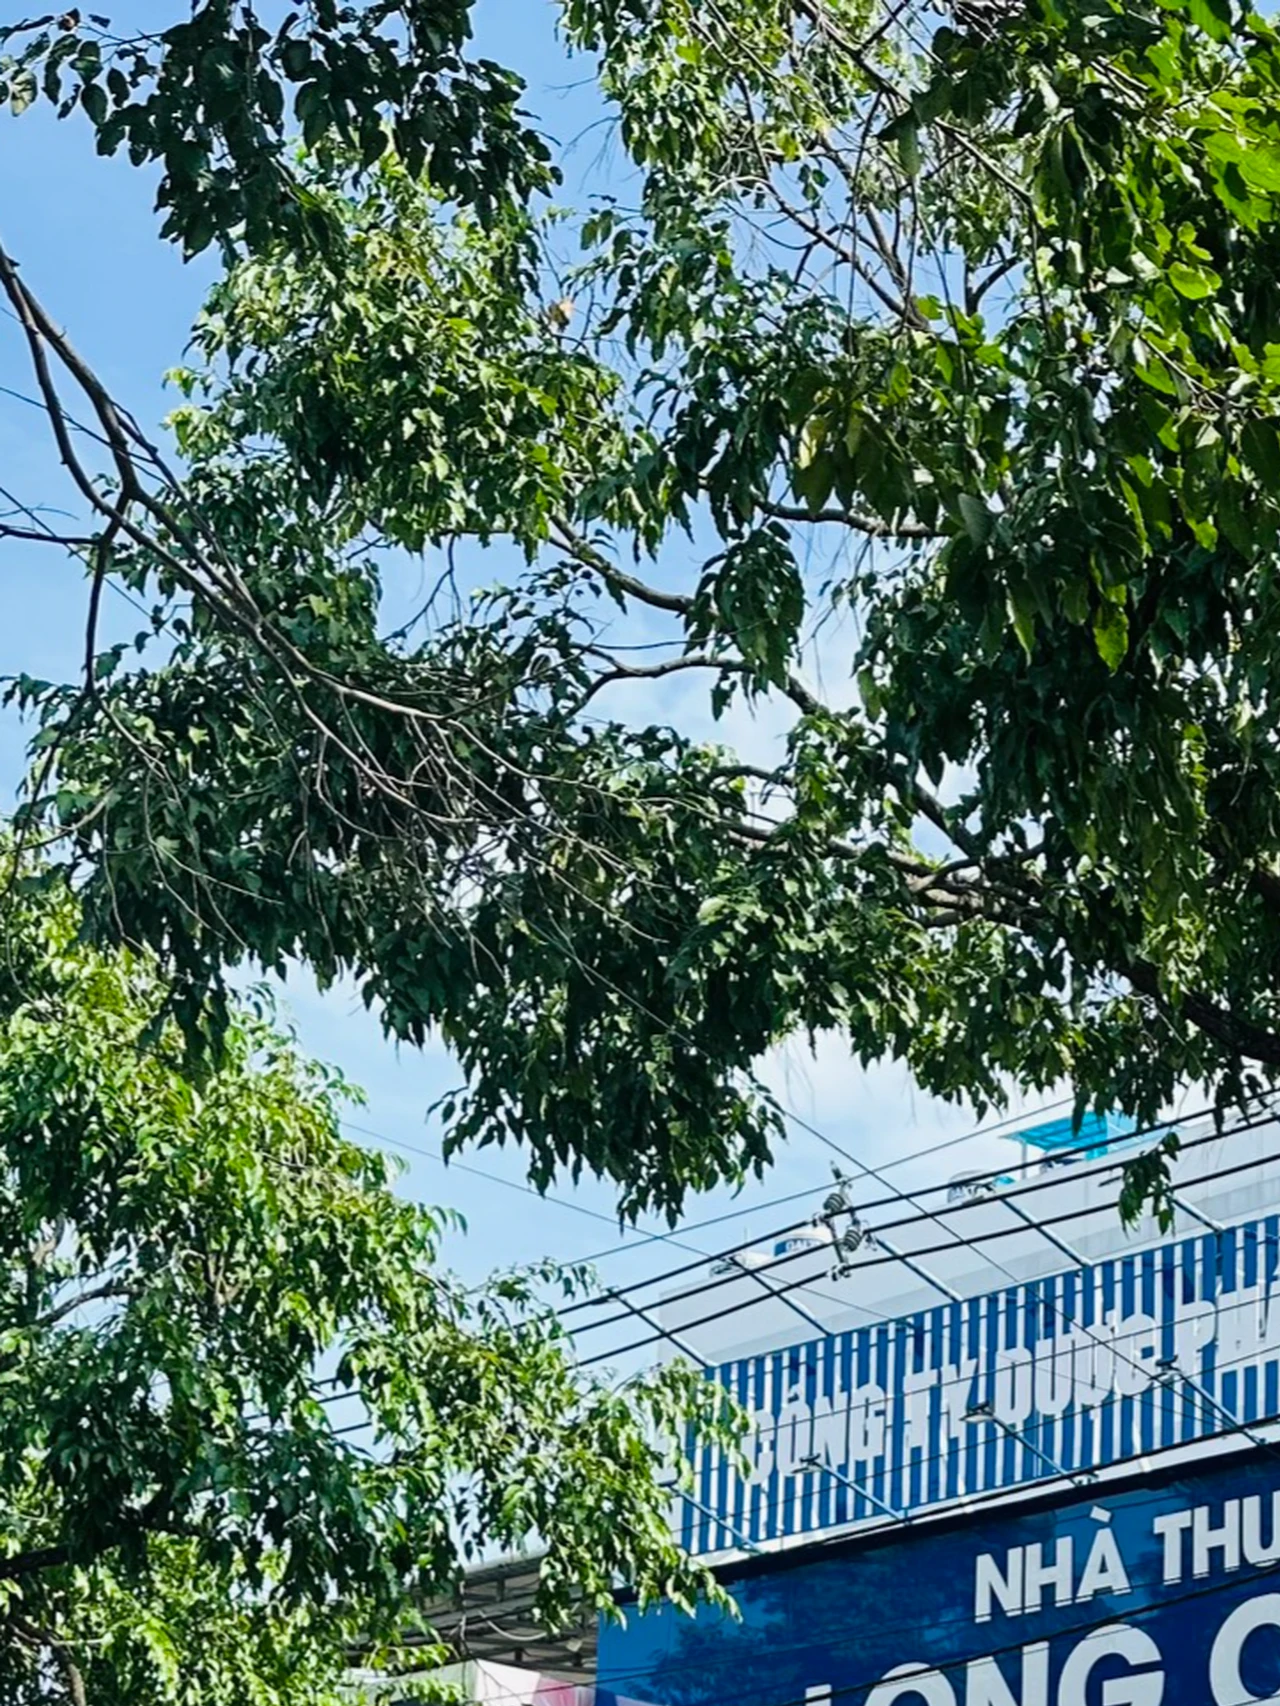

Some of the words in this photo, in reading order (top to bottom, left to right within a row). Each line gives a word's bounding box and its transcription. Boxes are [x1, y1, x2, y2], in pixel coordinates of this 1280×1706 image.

[743, 1382, 887, 1486] CÔNG
[903, 1355, 979, 1448] TY
[974, 1506, 1132, 1623] NHÀ
